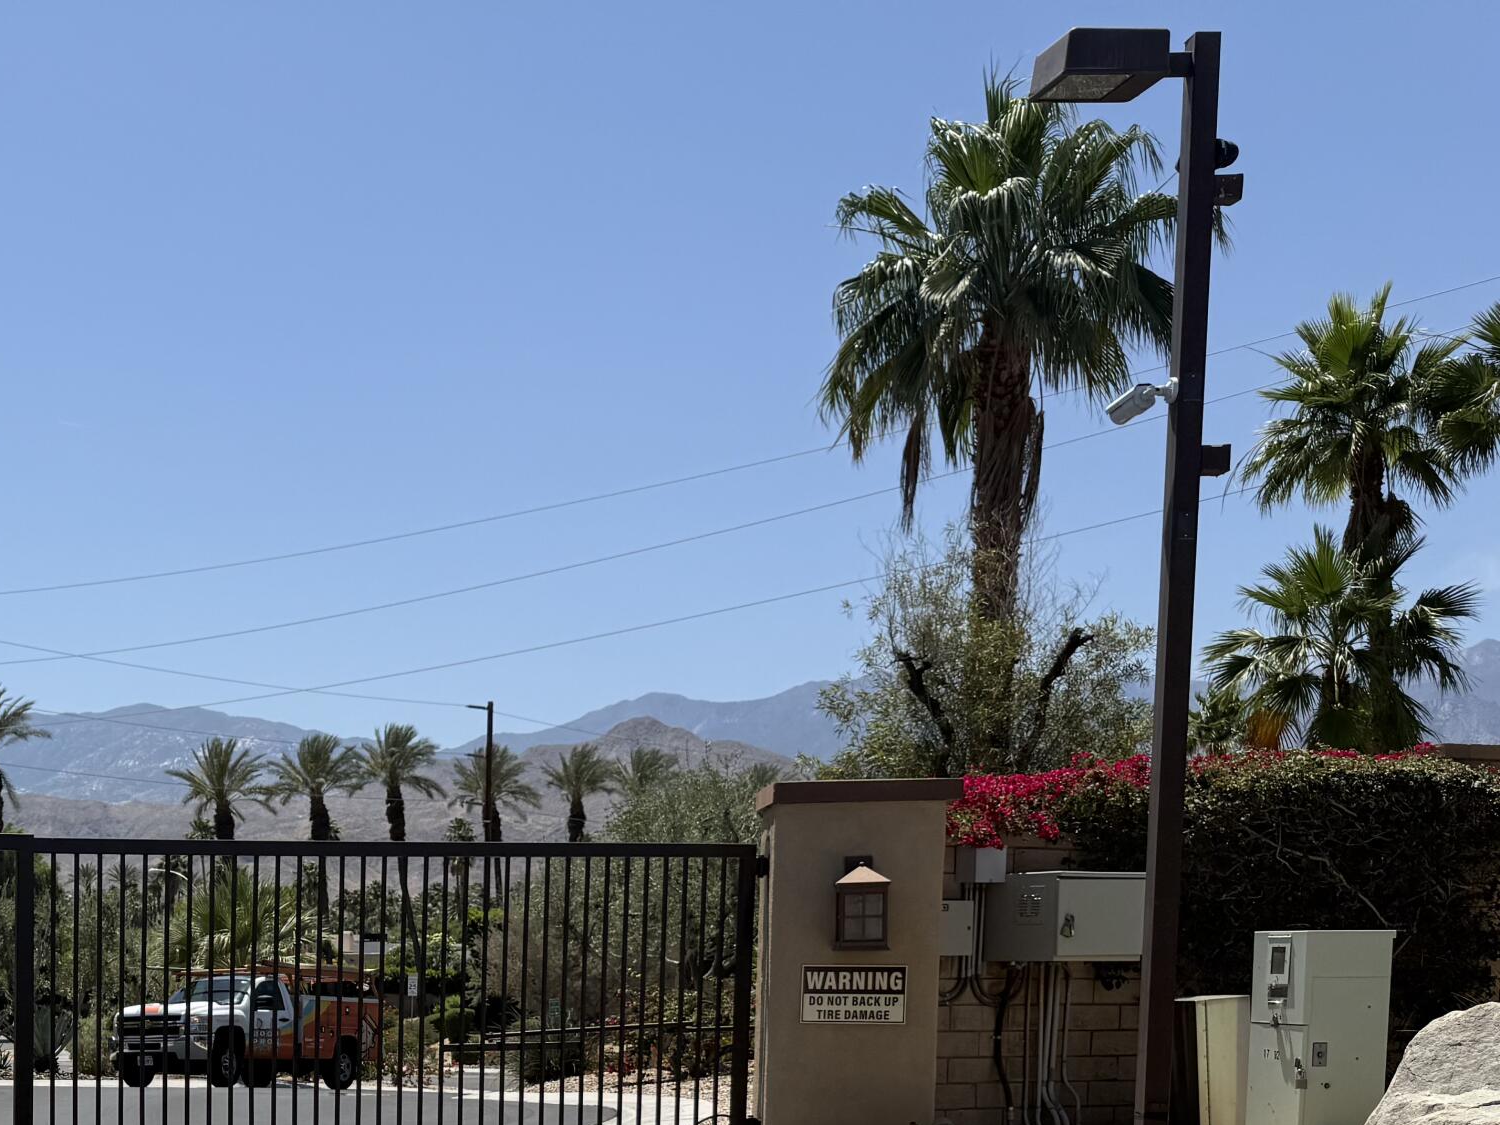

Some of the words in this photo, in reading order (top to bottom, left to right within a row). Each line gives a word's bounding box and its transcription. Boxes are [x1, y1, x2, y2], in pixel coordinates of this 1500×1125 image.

[806, 971, 903, 990] WARNING
[809, 996, 823, 1006] DO
[827, 996, 849, 1006] NOT
[852, 996, 881, 1007] BACK
[884, 996, 899, 1006] UP
[816, 1009, 841, 1020] TIRE
[844, 1010, 890, 1021] DAMAGE
